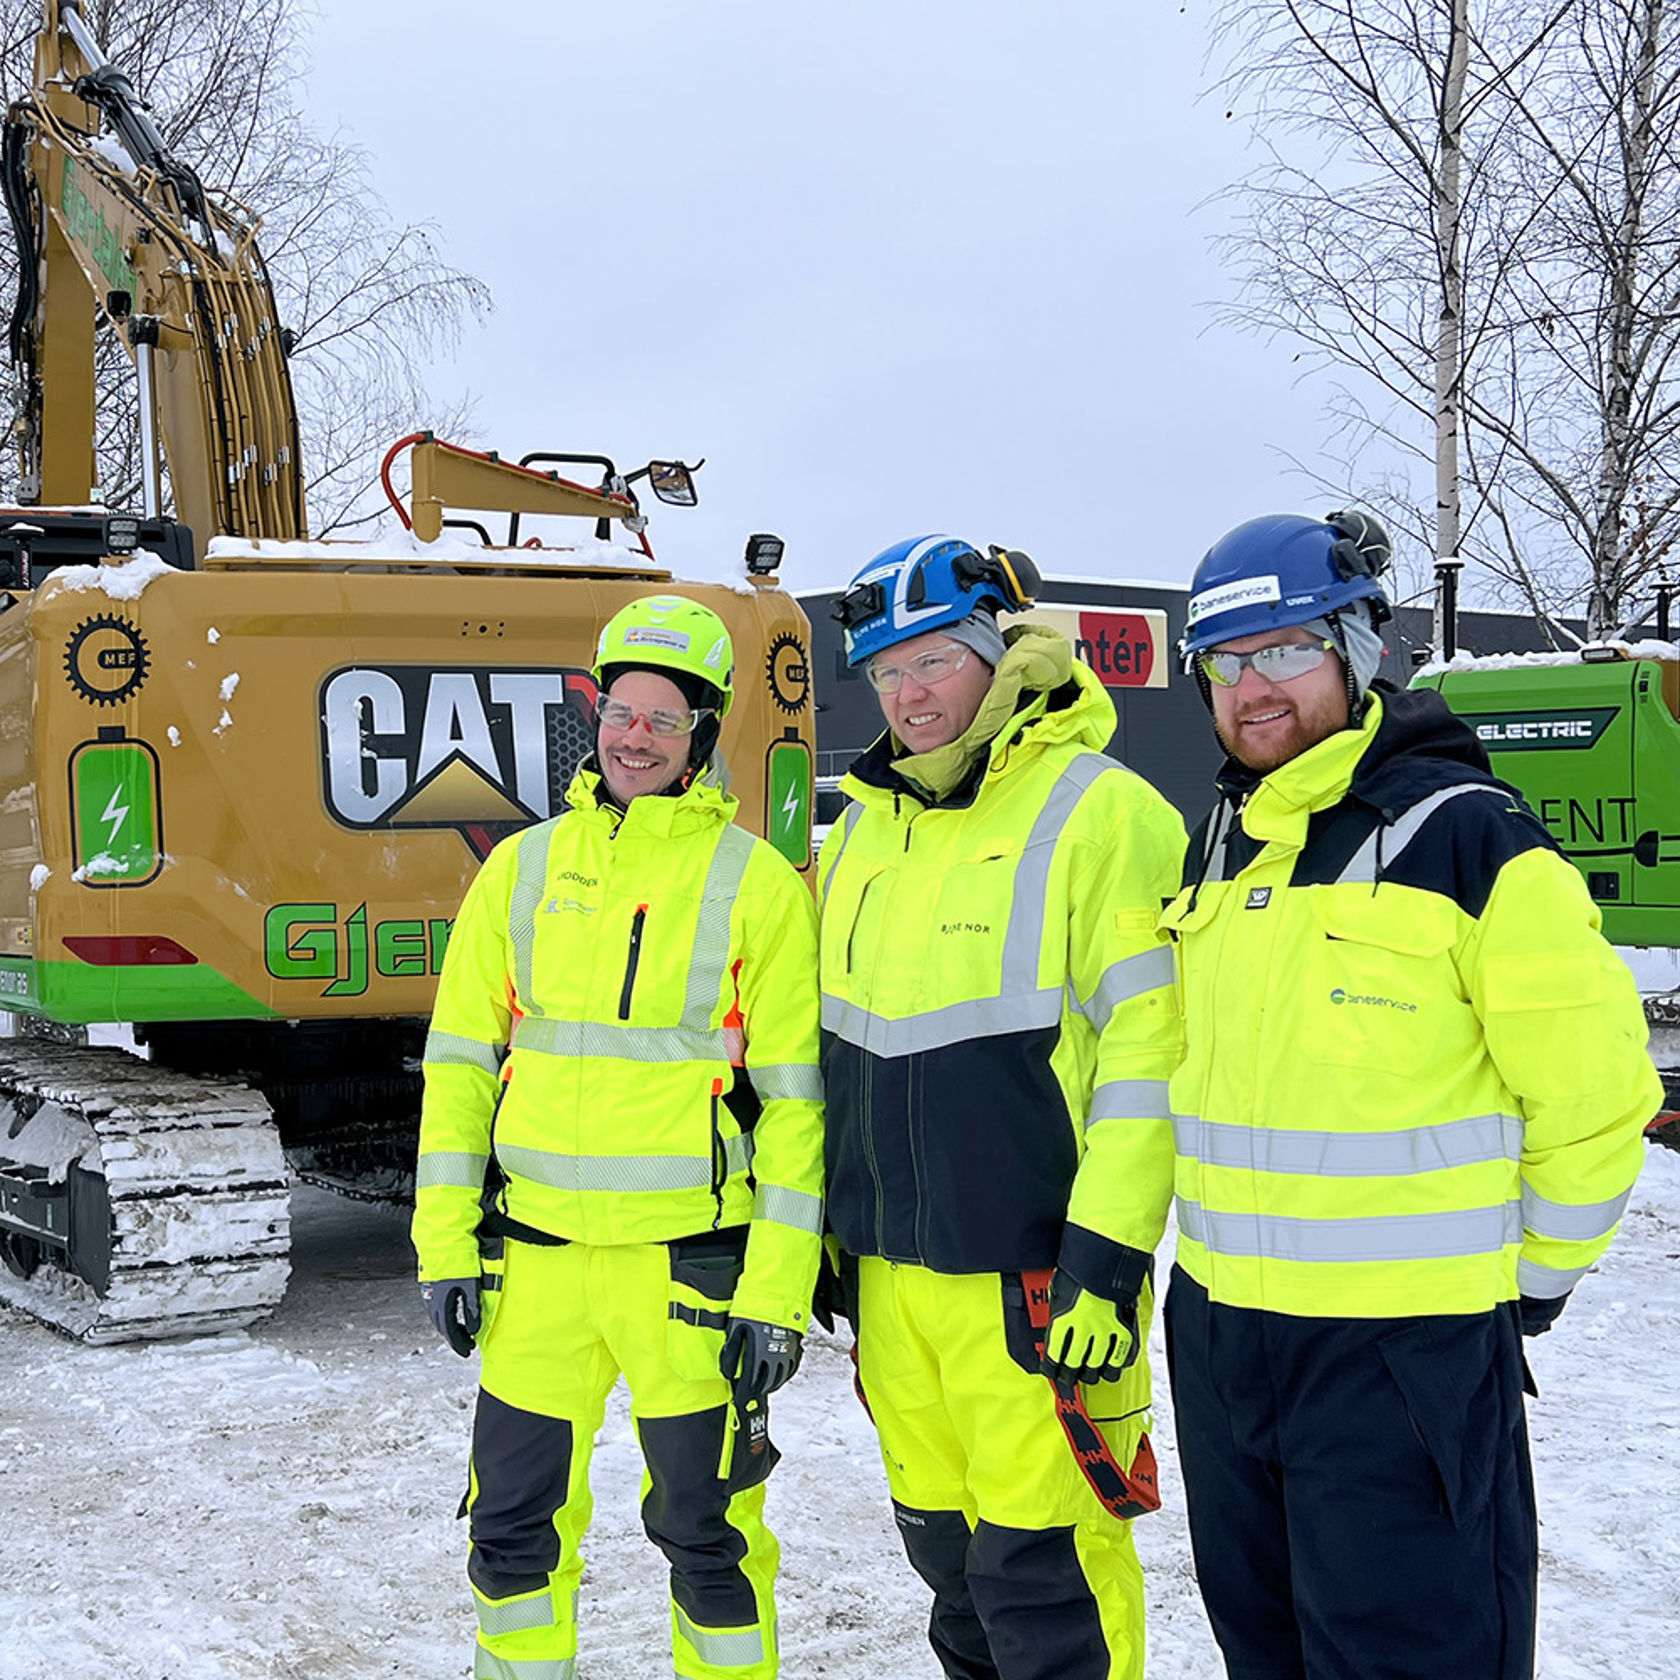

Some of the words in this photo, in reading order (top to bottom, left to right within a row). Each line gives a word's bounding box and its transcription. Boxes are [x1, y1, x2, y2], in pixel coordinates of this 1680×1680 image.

[104, 653, 136, 665] MEF
[1075, 627, 1148, 674] ntér
[1476, 720, 1592, 740] ELECTRIC
[325, 670, 564, 823] CAT
[965, 923, 990, 934] NOR
